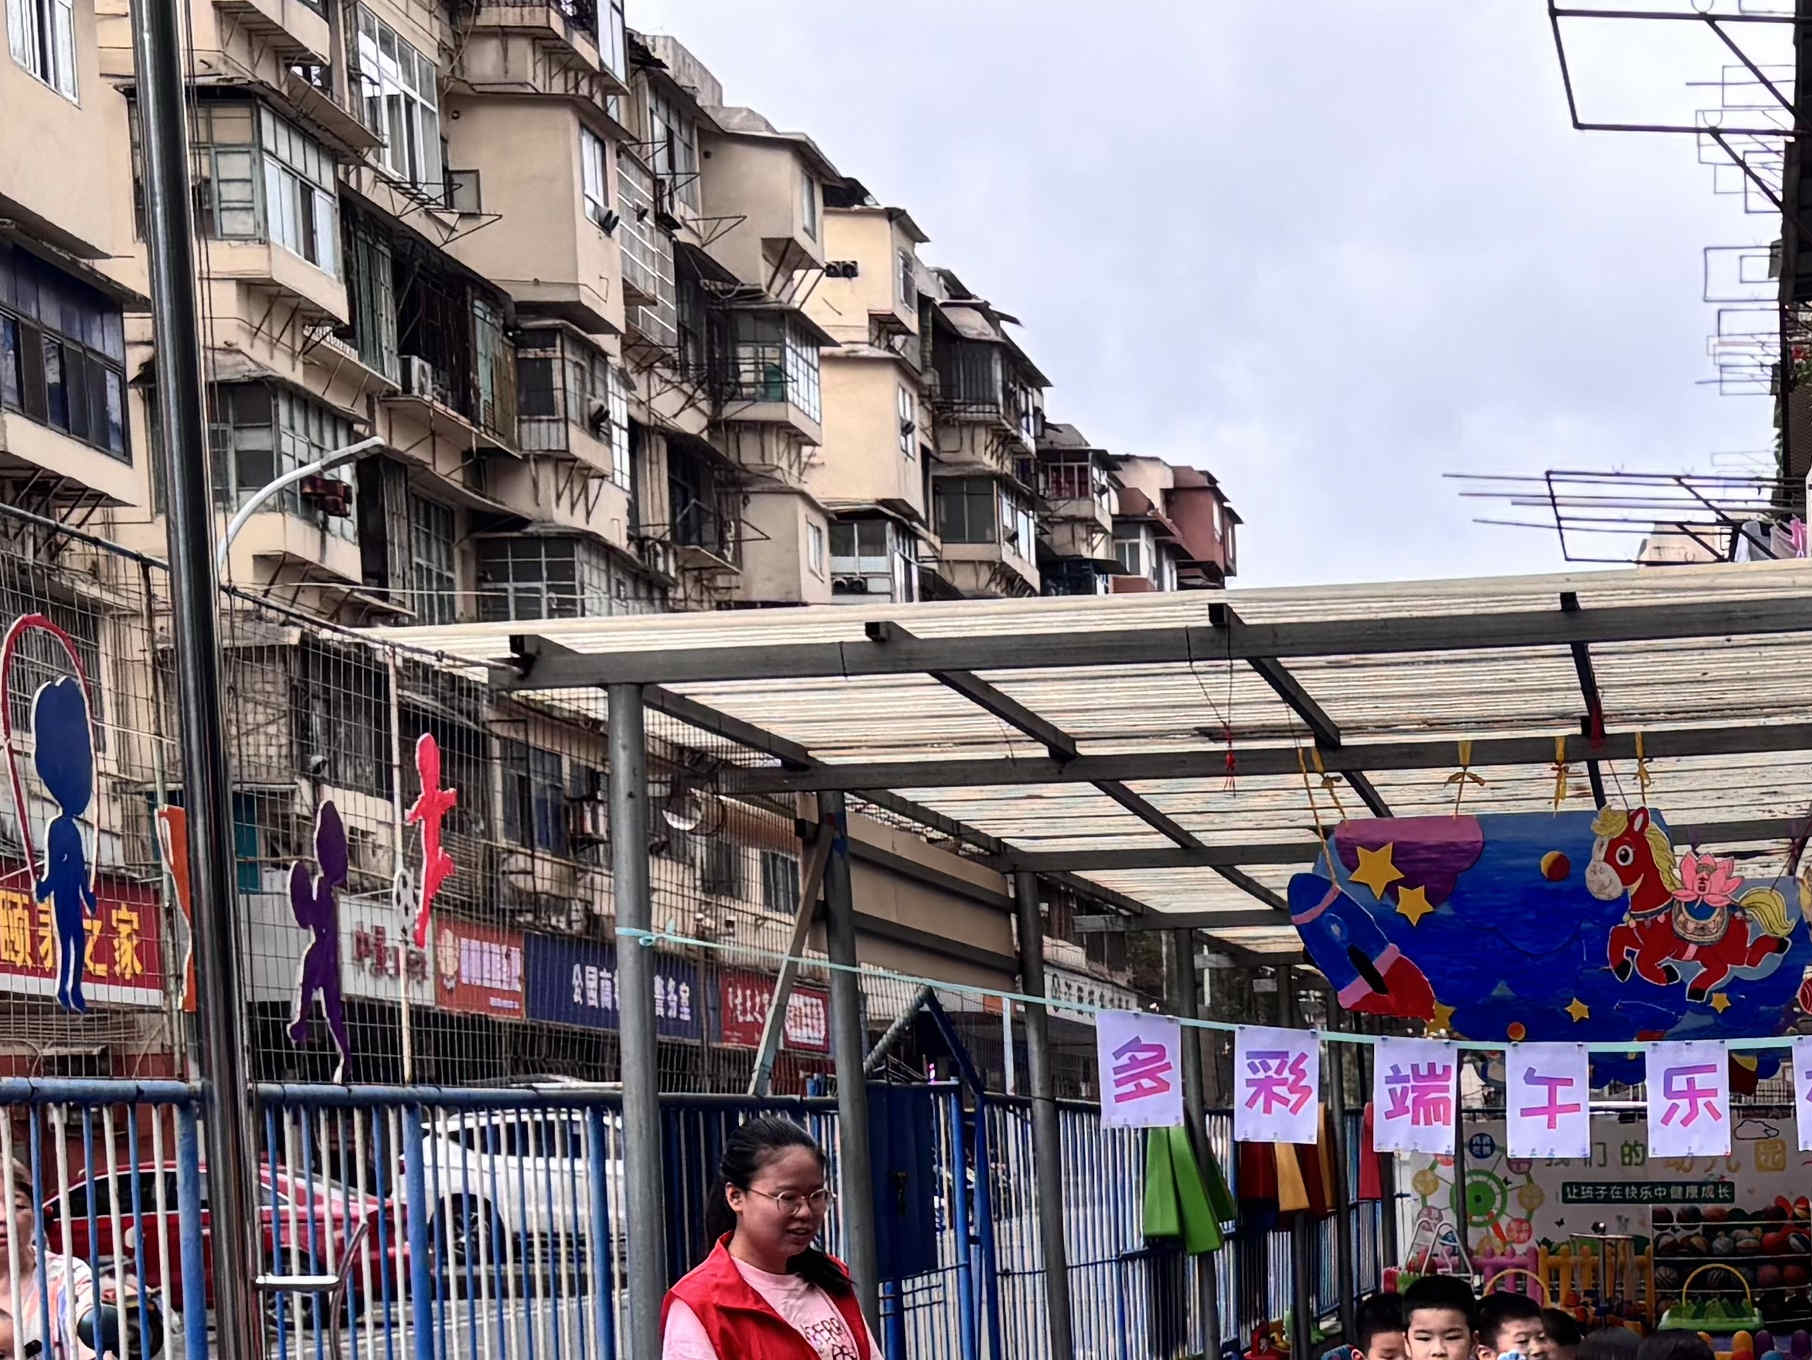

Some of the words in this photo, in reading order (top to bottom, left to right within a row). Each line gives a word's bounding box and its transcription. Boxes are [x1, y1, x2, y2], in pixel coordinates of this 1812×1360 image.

[1566, 1184, 1732, 1201] 让孩子在快乐中健康成长
